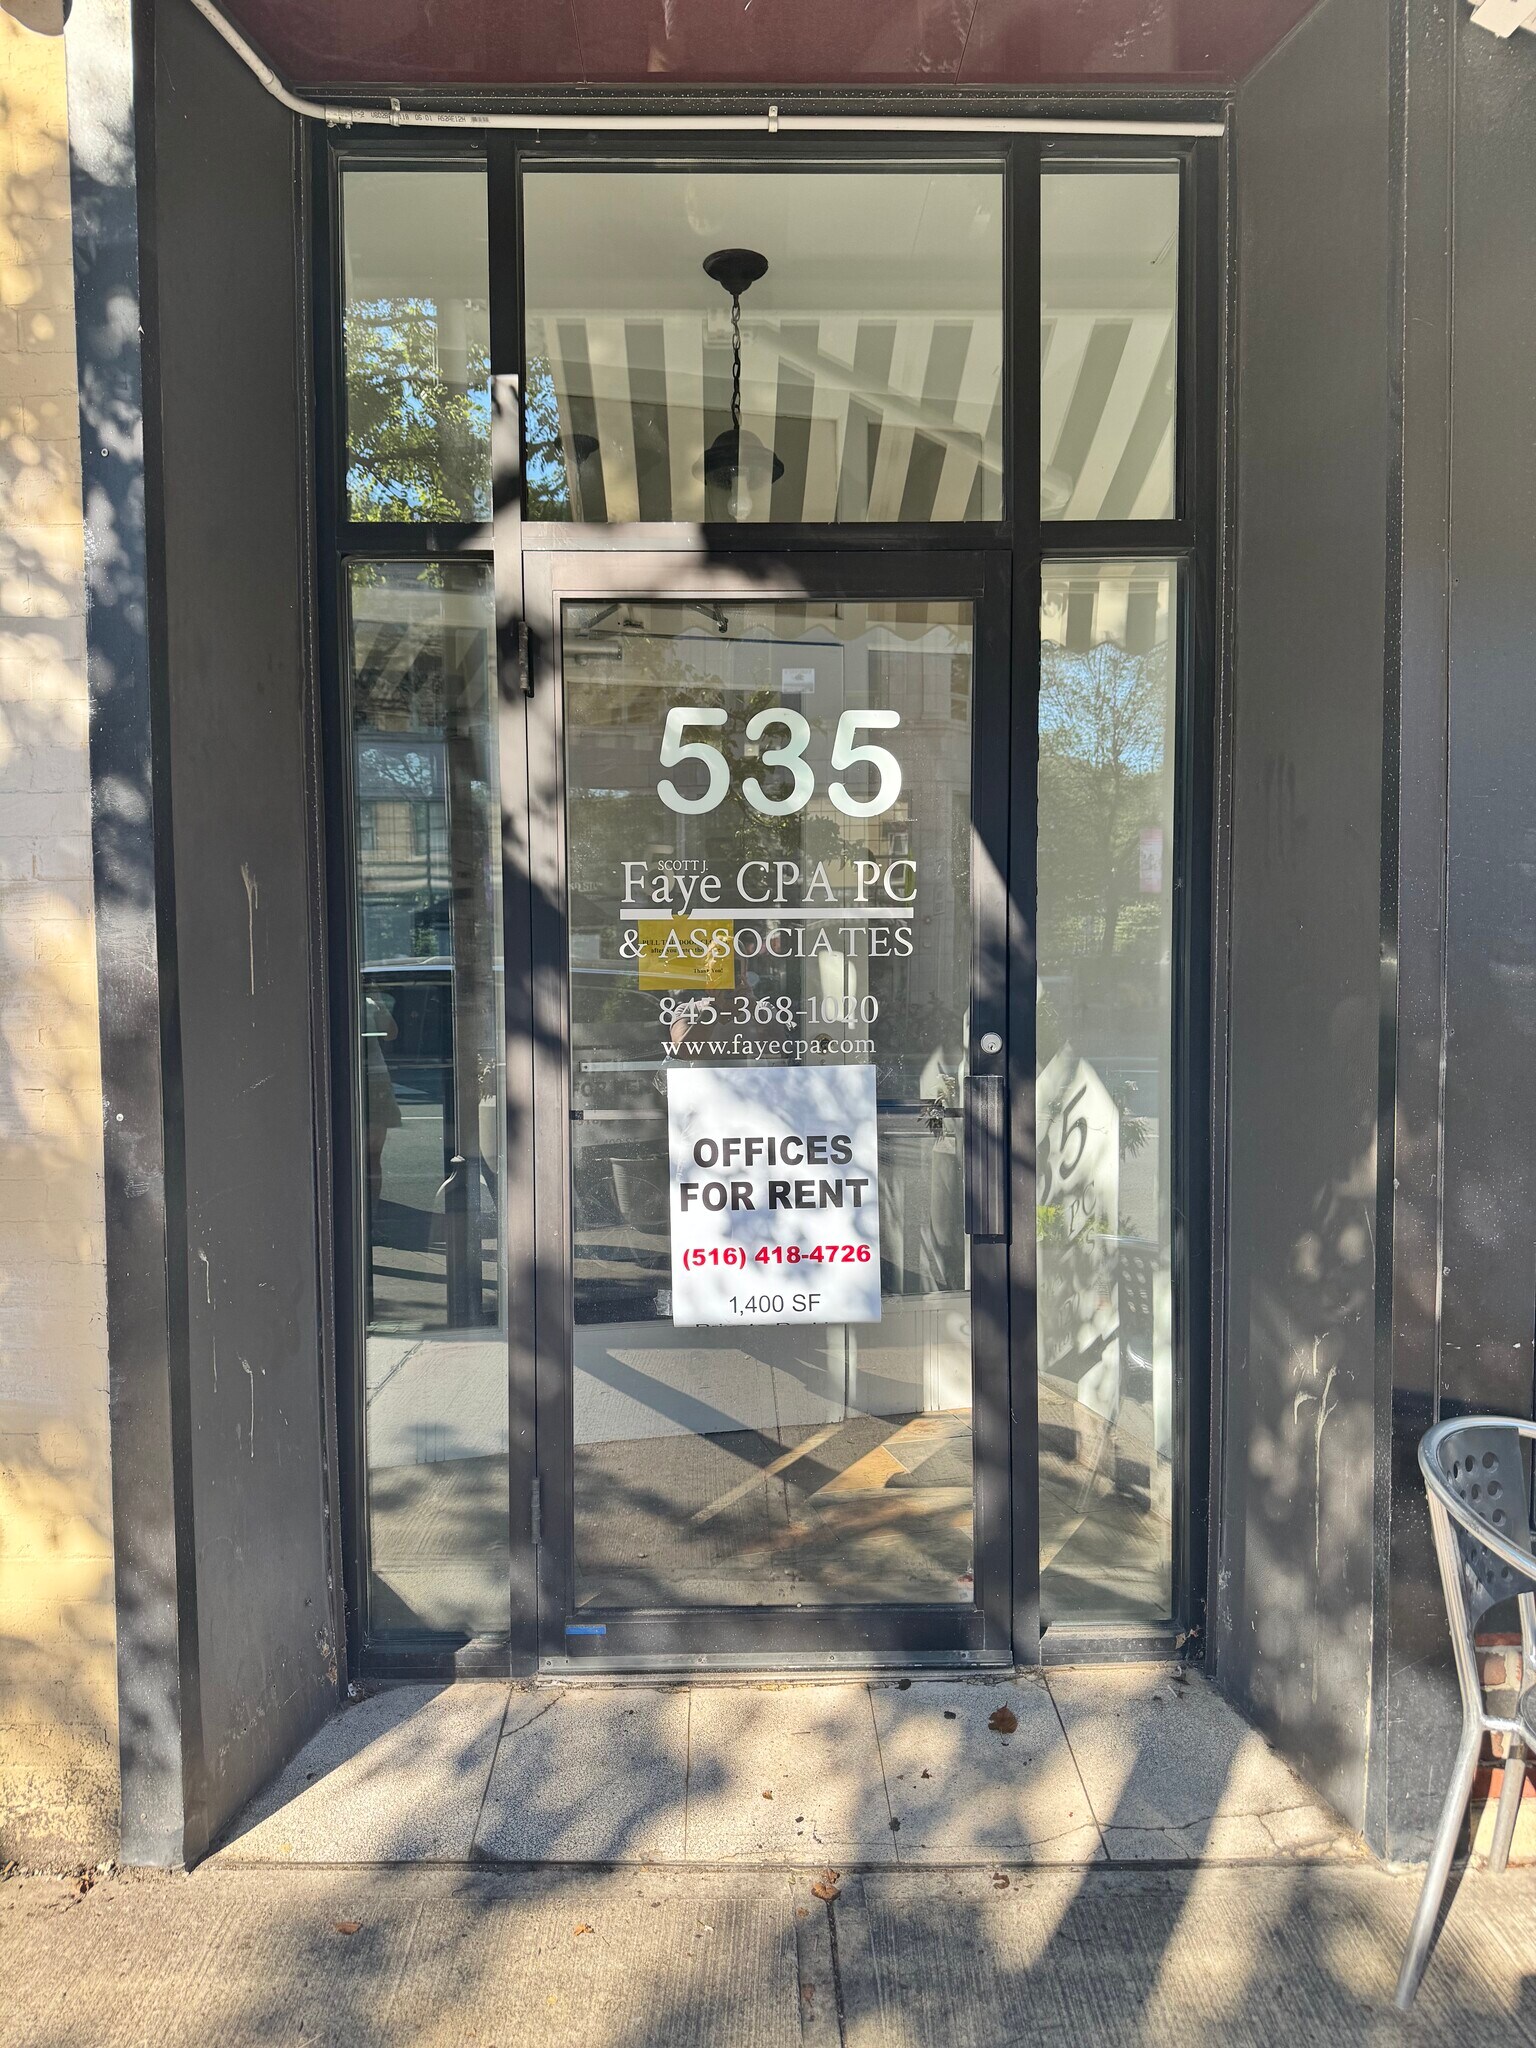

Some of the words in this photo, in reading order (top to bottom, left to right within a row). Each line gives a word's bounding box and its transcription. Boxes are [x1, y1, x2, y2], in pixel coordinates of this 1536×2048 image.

[657, 707, 902, 817] 535
[657, 860, 699, 871] SCOTT
[700, 860, 709, 874] J.
[620, 861, 722, 916] Faye
[735, 860, 838, 903] CPA
[853, 860, 918, 902] PC
[619, 928, 648, 959] &
[662, 926, 915, 958] ASSOCIATES
[658, 995, 879, 1025] 845-368-1020
[661, 1033, 876, 1060] www.fayecpa.com
[693, 1134, 853, 1168] OFFICES
[680, 1181, 756, 1212] FOR
[768, 1178, 869, 1210] RENT
[682, 1246, 747, 1271] (516)
[754, 1244, 872, 1264] 418-4726
[729, 1294, 785, 1316] 1,400
[792, 1293, 821, 1312] SF
